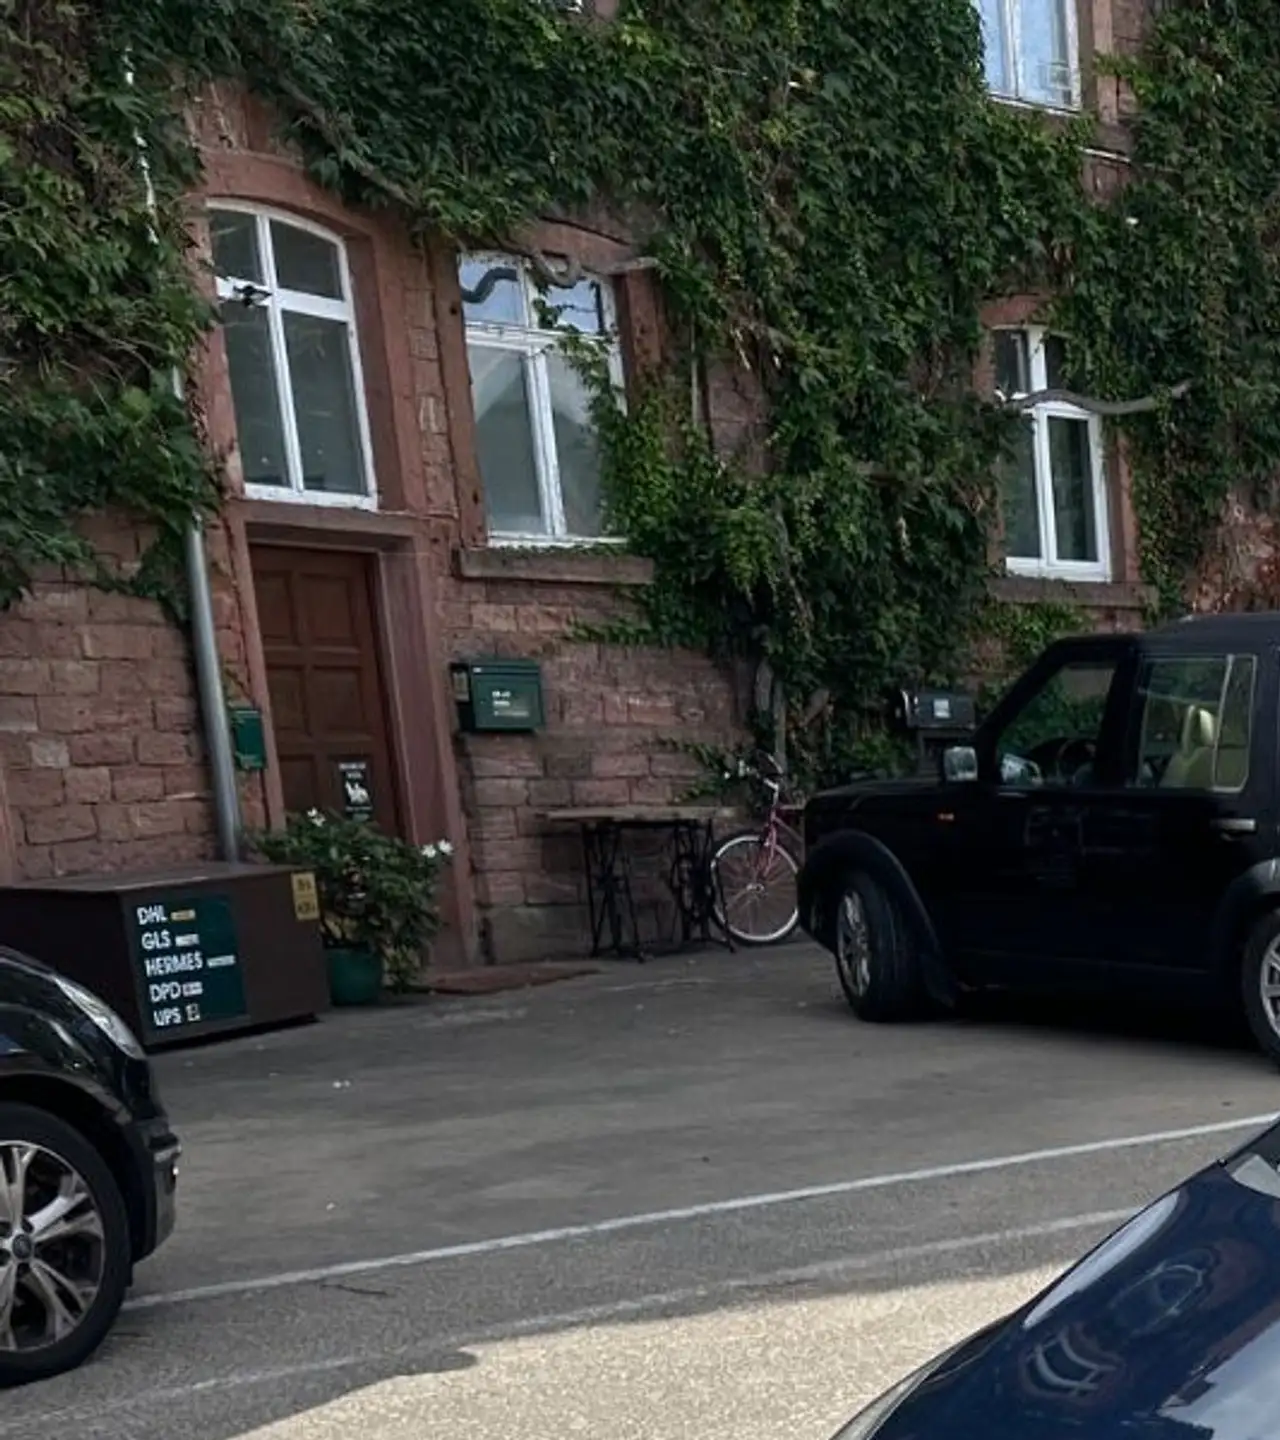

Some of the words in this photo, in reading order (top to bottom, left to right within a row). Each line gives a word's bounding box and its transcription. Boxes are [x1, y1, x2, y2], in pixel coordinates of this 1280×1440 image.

[136, 904, 168, 925] DHL
[141, 930, 171, 950] GLS
[144, 951, 203, 977] HERMES
[149, 981, 181, 1002] DPD
[153, 1007, 182, 1027] UPS
